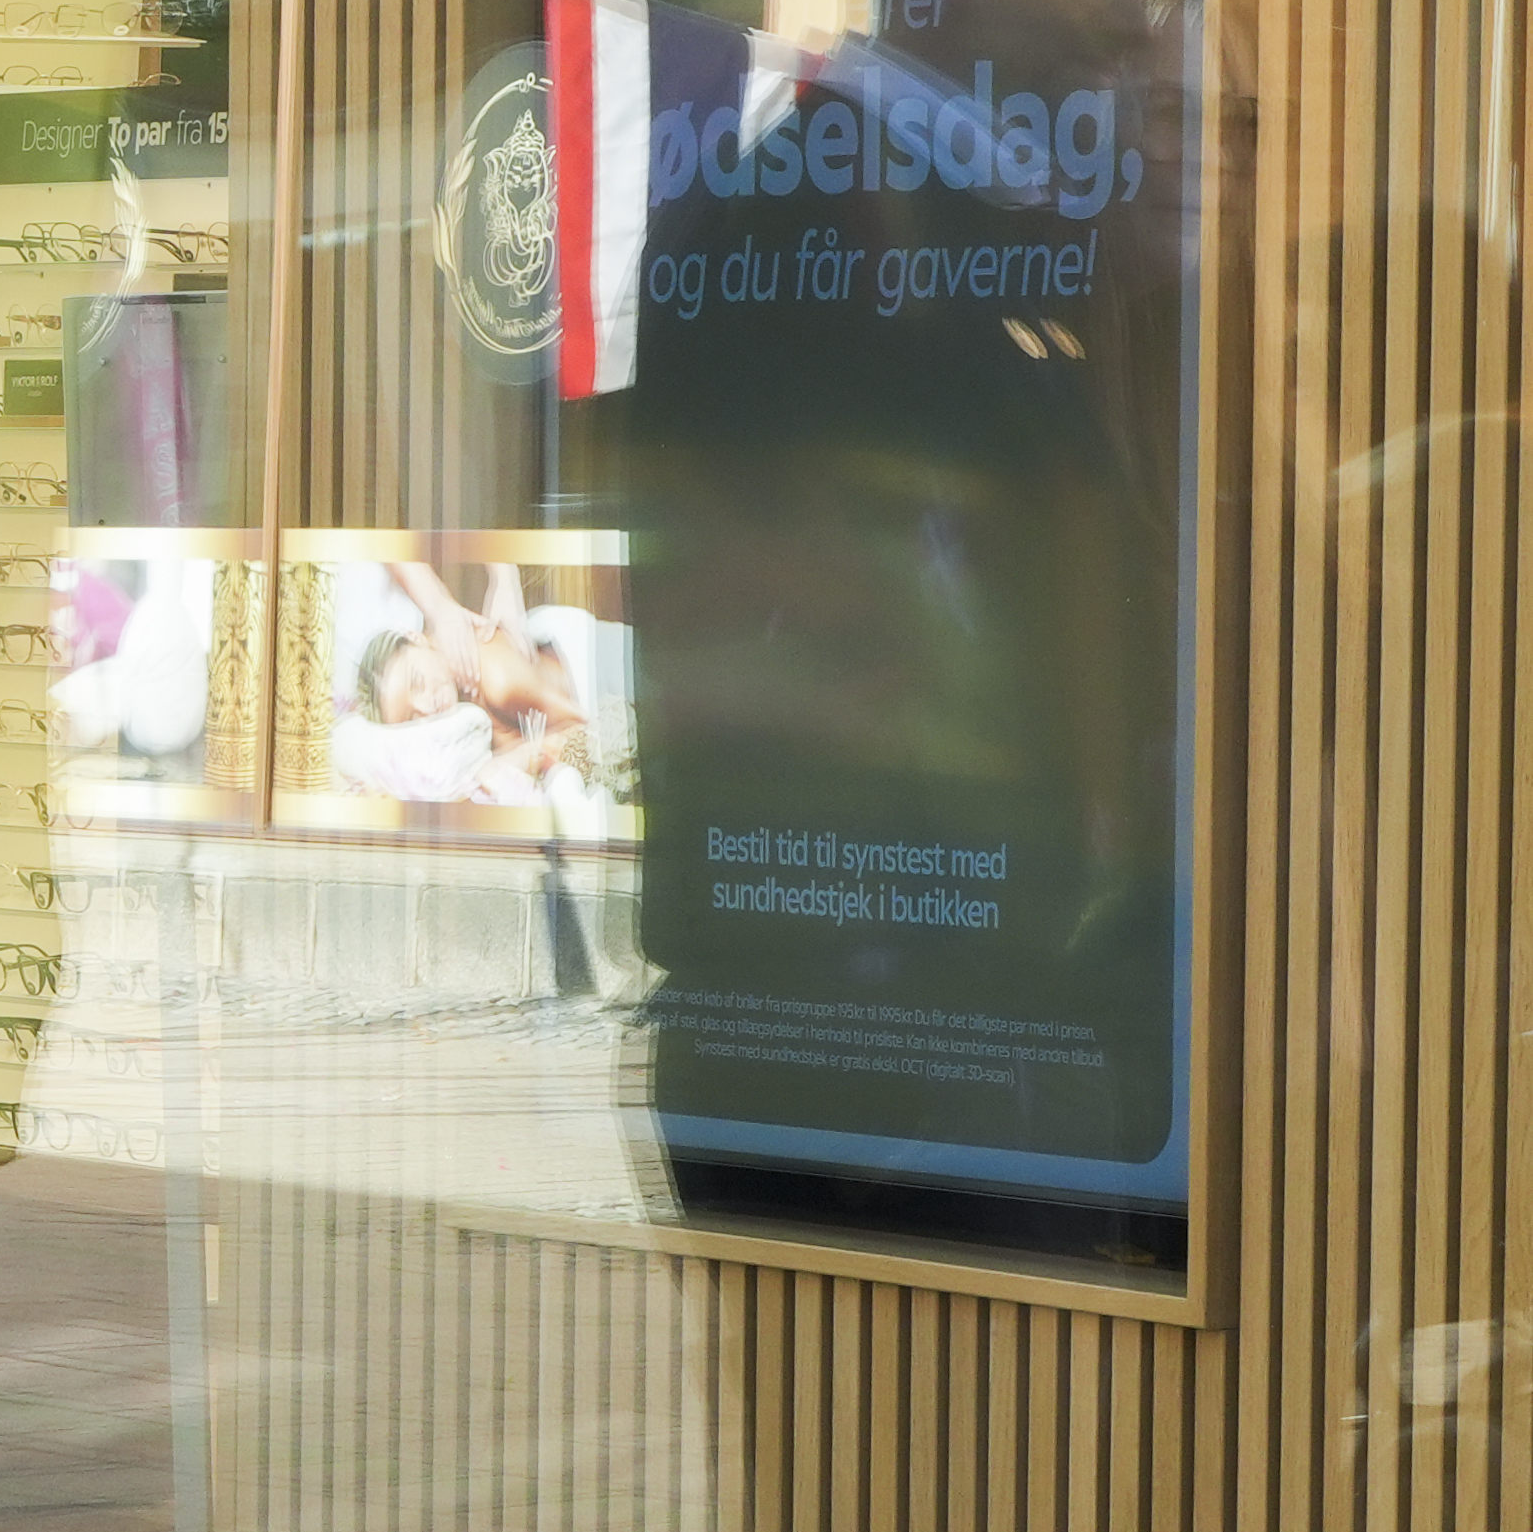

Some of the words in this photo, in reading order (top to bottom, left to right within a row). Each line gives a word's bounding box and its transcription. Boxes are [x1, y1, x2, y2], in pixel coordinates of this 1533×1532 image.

[21, 117, 104, 159] Designer
[108, 116, 131, 149] To
[135, 120, 173, 156] par
[176, 109, 203, 146] fra
[207, 110, 229, 145] 15
[649, 60, 1144, 221] ødselsdag,
[648, 253, 708, 321] og
[720, 234, 779, 303] du
[794, 226, 866, 301] får
[876, 227, 1099, 318] gaverne!
[707, 826, 771, 865] Bestil
[775, 828, 809, 867] tid
[814, 830, 837, 868] til
[842, 840, 946, 880] synstest
[951, 842, 1007, 881] med
[712, 876, 873, 927] sundhedstjek
[879, 883, 886, 921] i
[892, 885, 999, 930] butikken
